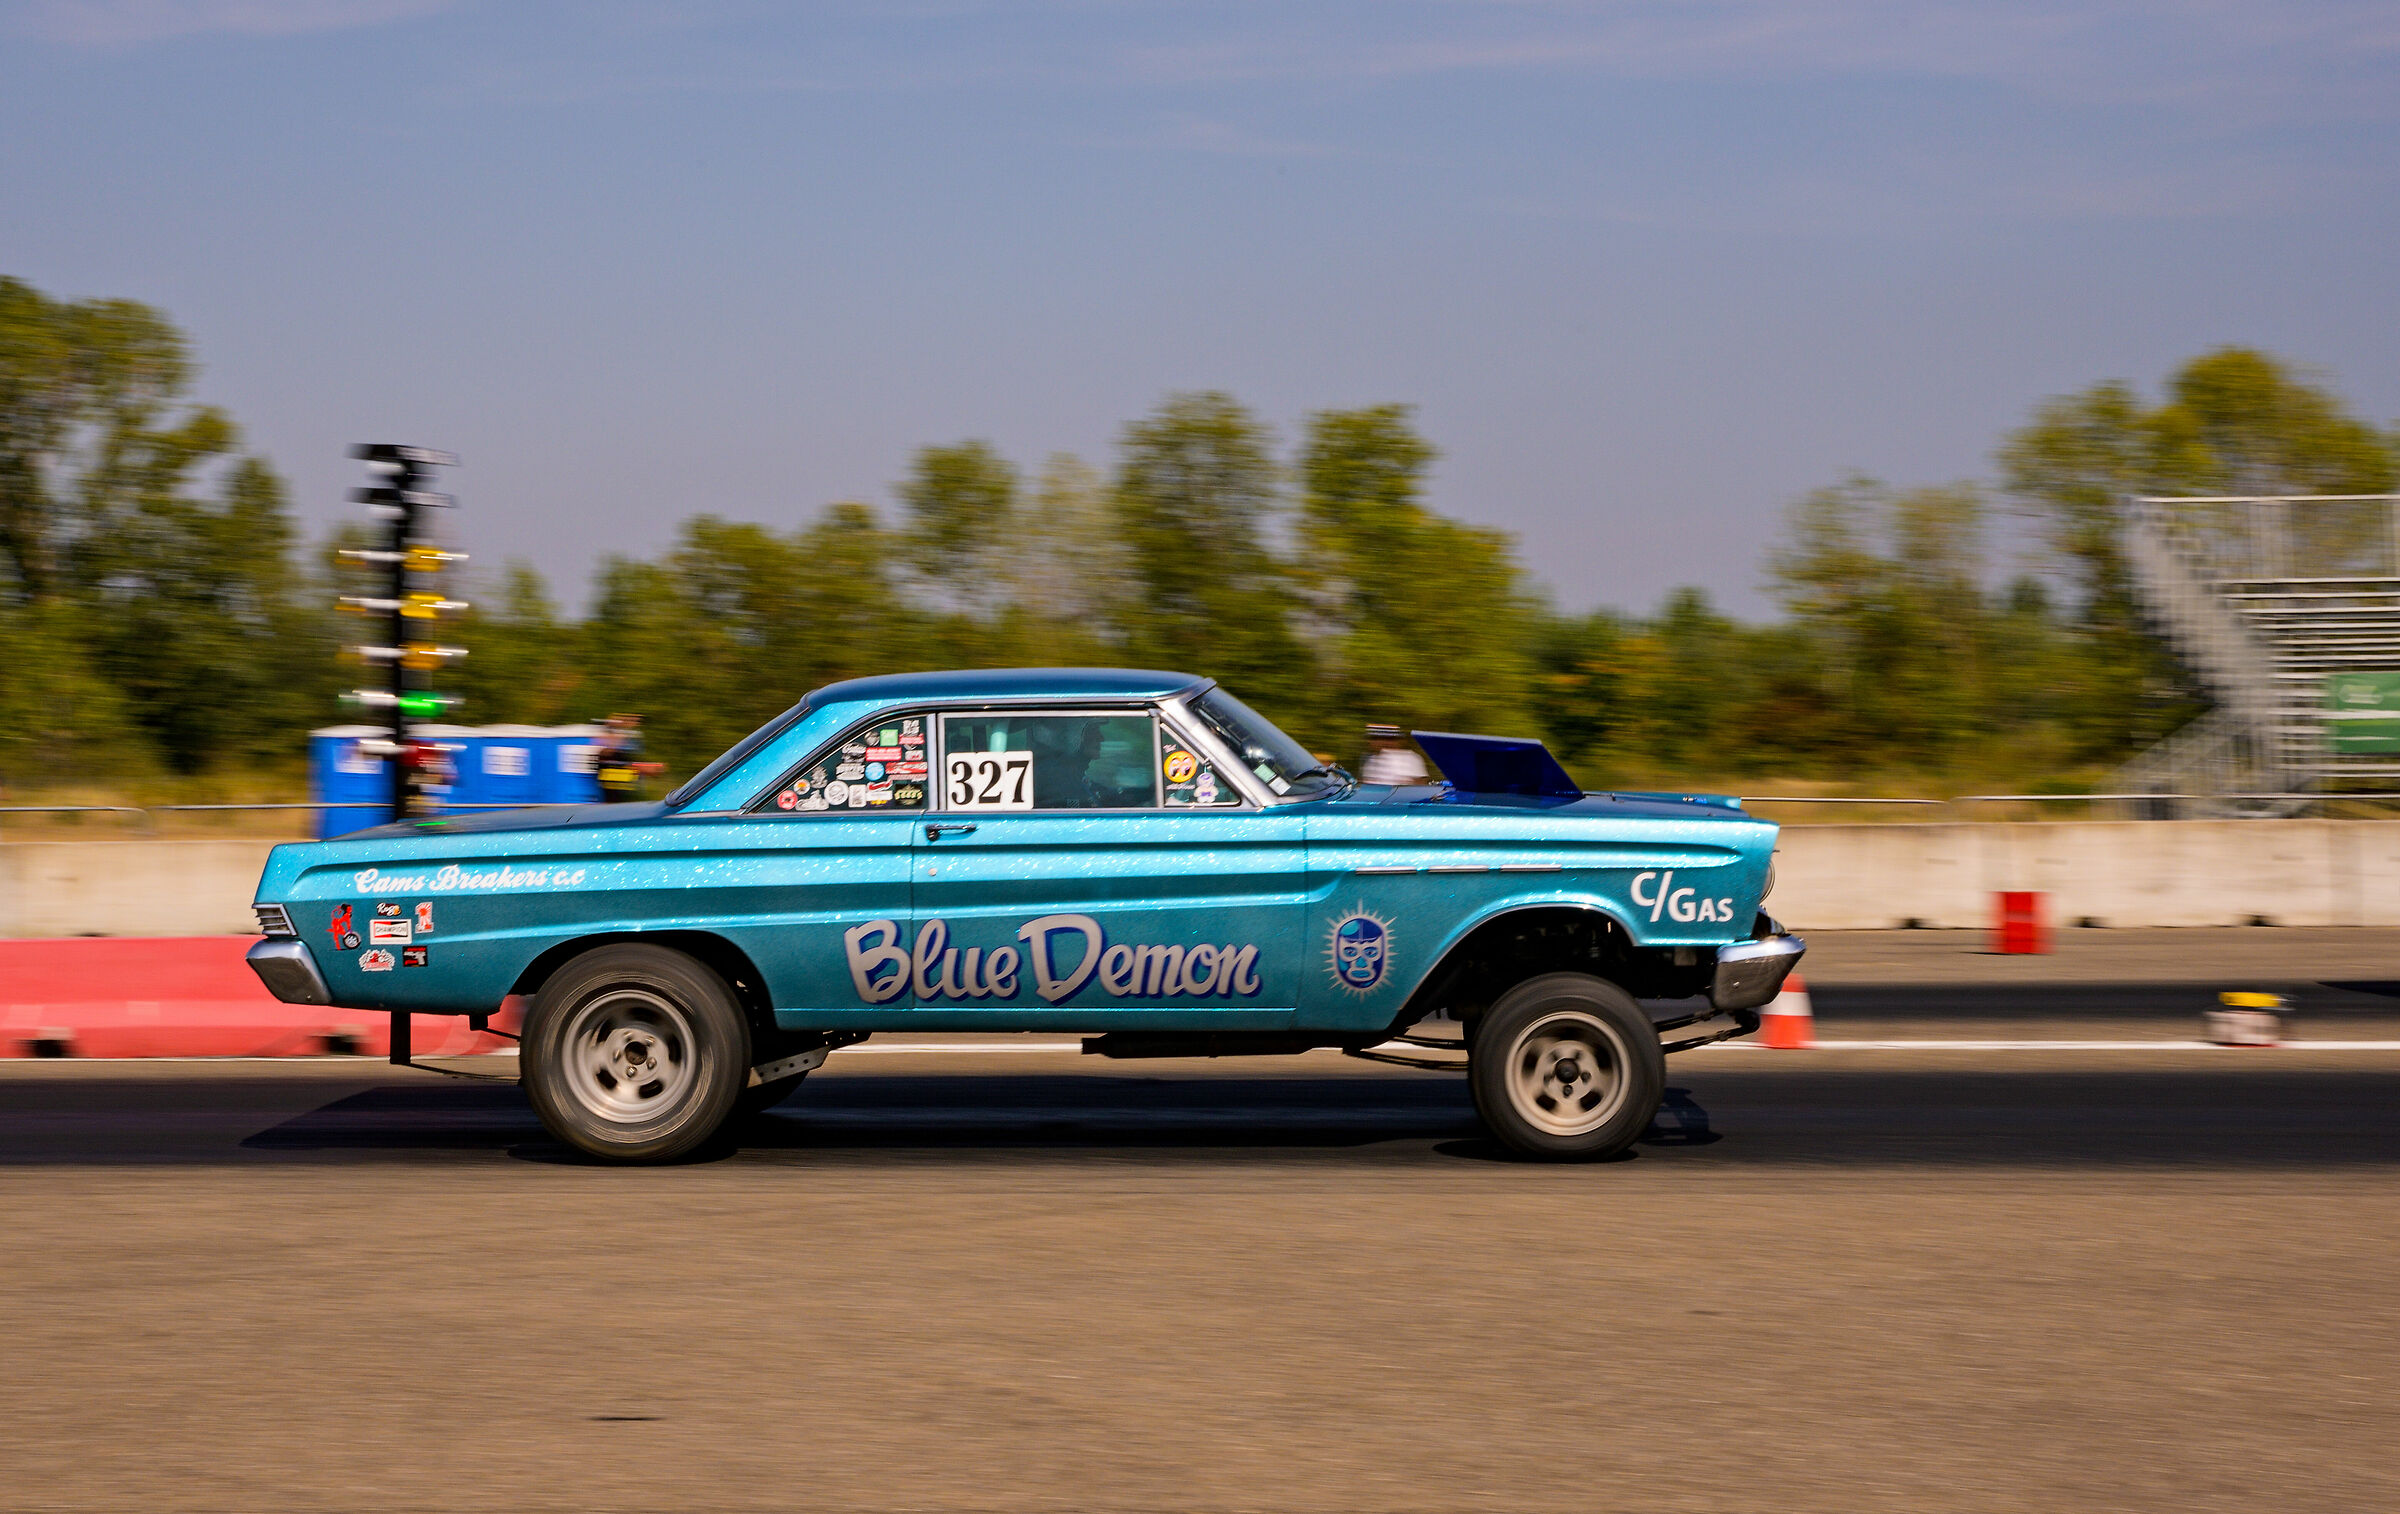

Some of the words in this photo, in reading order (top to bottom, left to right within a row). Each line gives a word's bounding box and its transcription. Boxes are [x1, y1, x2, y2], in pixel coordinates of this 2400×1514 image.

[951, 760, 1030, 806] 327
[354, 868, 426, 893] Cams
[429, 864, 548, 891] Breakers
[843, 918, 1021, 1005] Blue
[1016, 912, 1262, 1006] Demon
